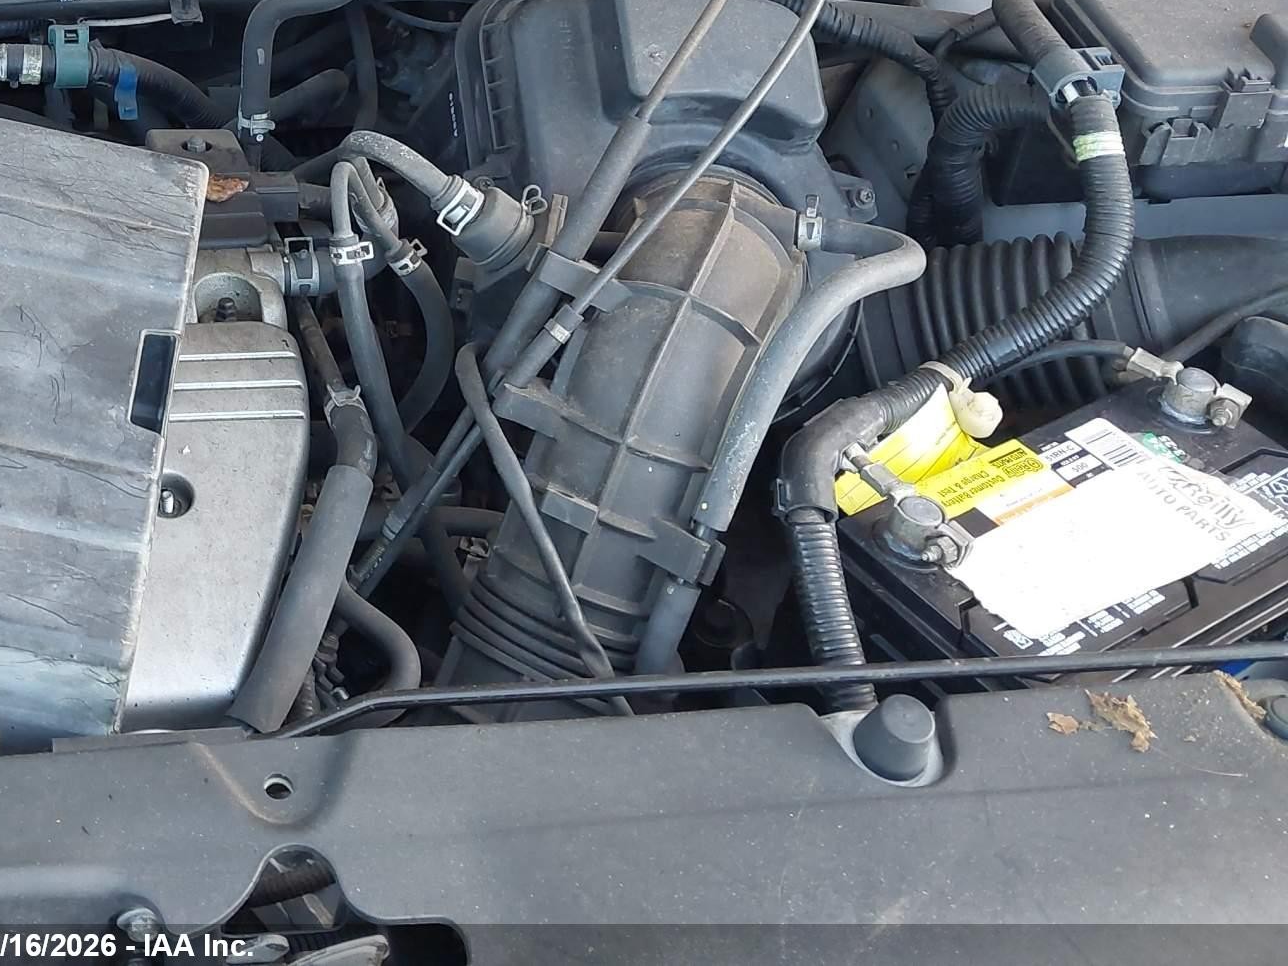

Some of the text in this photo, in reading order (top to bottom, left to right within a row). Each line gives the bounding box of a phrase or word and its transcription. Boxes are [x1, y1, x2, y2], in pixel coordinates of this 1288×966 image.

[936, 470, 990, 498] Charge & Test
[940, 475, 1006, 508] Customer Battery
[1136, 472, 1228, 541] AUTO PARTS
